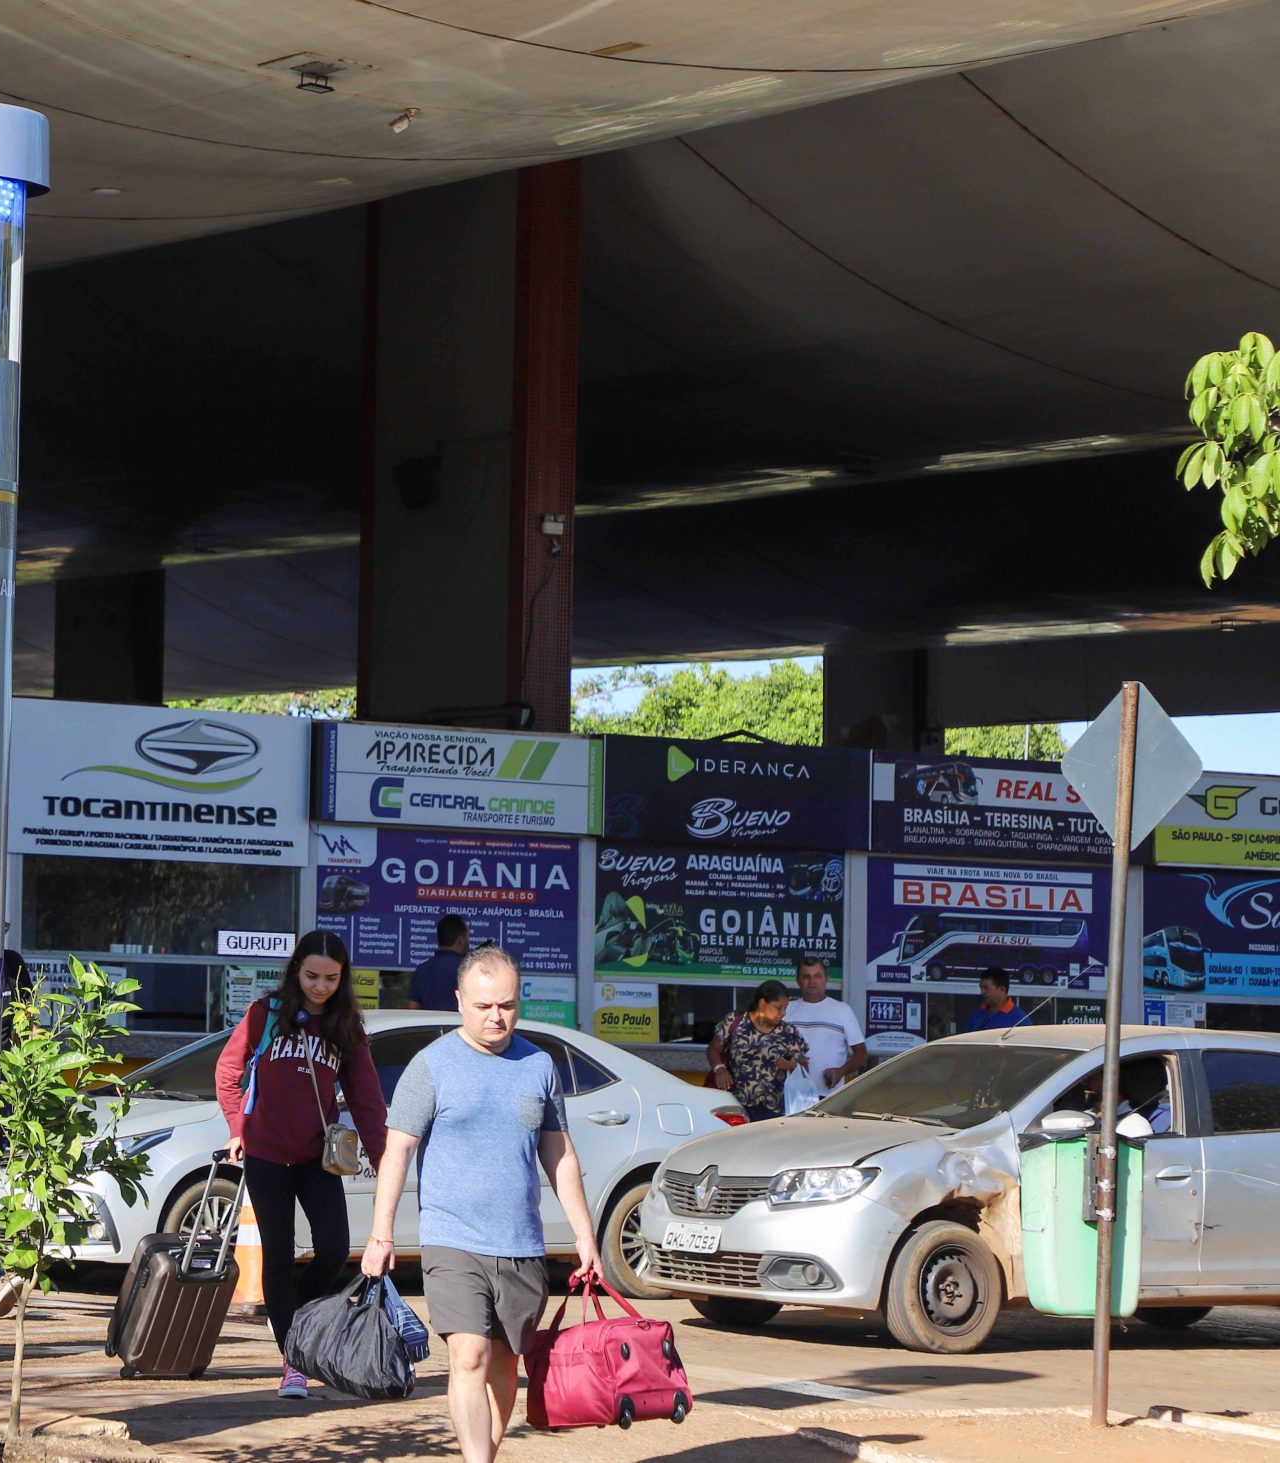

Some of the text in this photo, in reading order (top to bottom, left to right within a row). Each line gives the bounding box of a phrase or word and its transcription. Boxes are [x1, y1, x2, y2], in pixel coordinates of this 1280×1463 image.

[375, 730, 487, 744] VIAÇÃO NOSSA SENHORA
[366, 740, 496, 768] APARECIDA
[376, 760, 494, 778] Transportando Você!
[672, 758, 810, 780] LIDERANÇA
[996, 778, 1058, 802] REAL
[410, 792, 555, 815] CENTRAL CANINDÉ
[462, 812, 556, 826] TRANSPORTE E TURISMO
[686, 798, 791, 839] BUENO
[904, 806, 970, 826] BRASÍLIA
[985, 812, 1054, 831] TERESINA
[90, 831, 114, 839] PORTO
[731, 826, 778, 839] Viagens
[904, 826, 1091, 844] PLANALTINA SOBRADINHO TAGUATINGA VARGEM
[1172, 828, 1244, 843] SÃO PAULO SP
[904, 836, 926, 844] BREJO
[928, 836, 965, 846] ANAPURUS
[974, 839, 996, 848] SANTA
[996, 839, 1028, 850] QUITÉRIA
[1036, 843, 1079, 853] CHAPADINHA
[328, 857, 362, 865] TRANSPORTES
[599, 848, 676, 872] BUENO
[686, 854, 784, 874] ARAGUAÍNA
[380, 856, 570, 890] GOIÂNIA
[622, 871, 678, 890] Viagens
[927, 867, 943, 875] VIAJE
[960, 869, 980, 877] FROTA
[984, 870, 1000, 878] MAIS
[1003, 871, 1021, 879] NOVA
[1036, 873, 1059, 881] BRASIL
[418, 889, 534, 900] DIARIAMENTE 18:50
[902, 881, 1083, 912] BRASÍLIA
[394, 904, 564, 918] IMPERATRIZ URUAÇU ANÁPOLIS BRASÍLIA
[700, 906, 836, 937] GOIÂNIA
[226, 936, 288, 952] GURUPI
[700, 934, 837, 949] BELÉM IMPERATRIZ
[978, 935, 1032, 946] REAL SUL
[601, 1011, 651, 1026] São Paulo
[1067, 1014, 1104, 1024] GOIÂNIA
[270, 1035, 340, 1073] HARVAR
